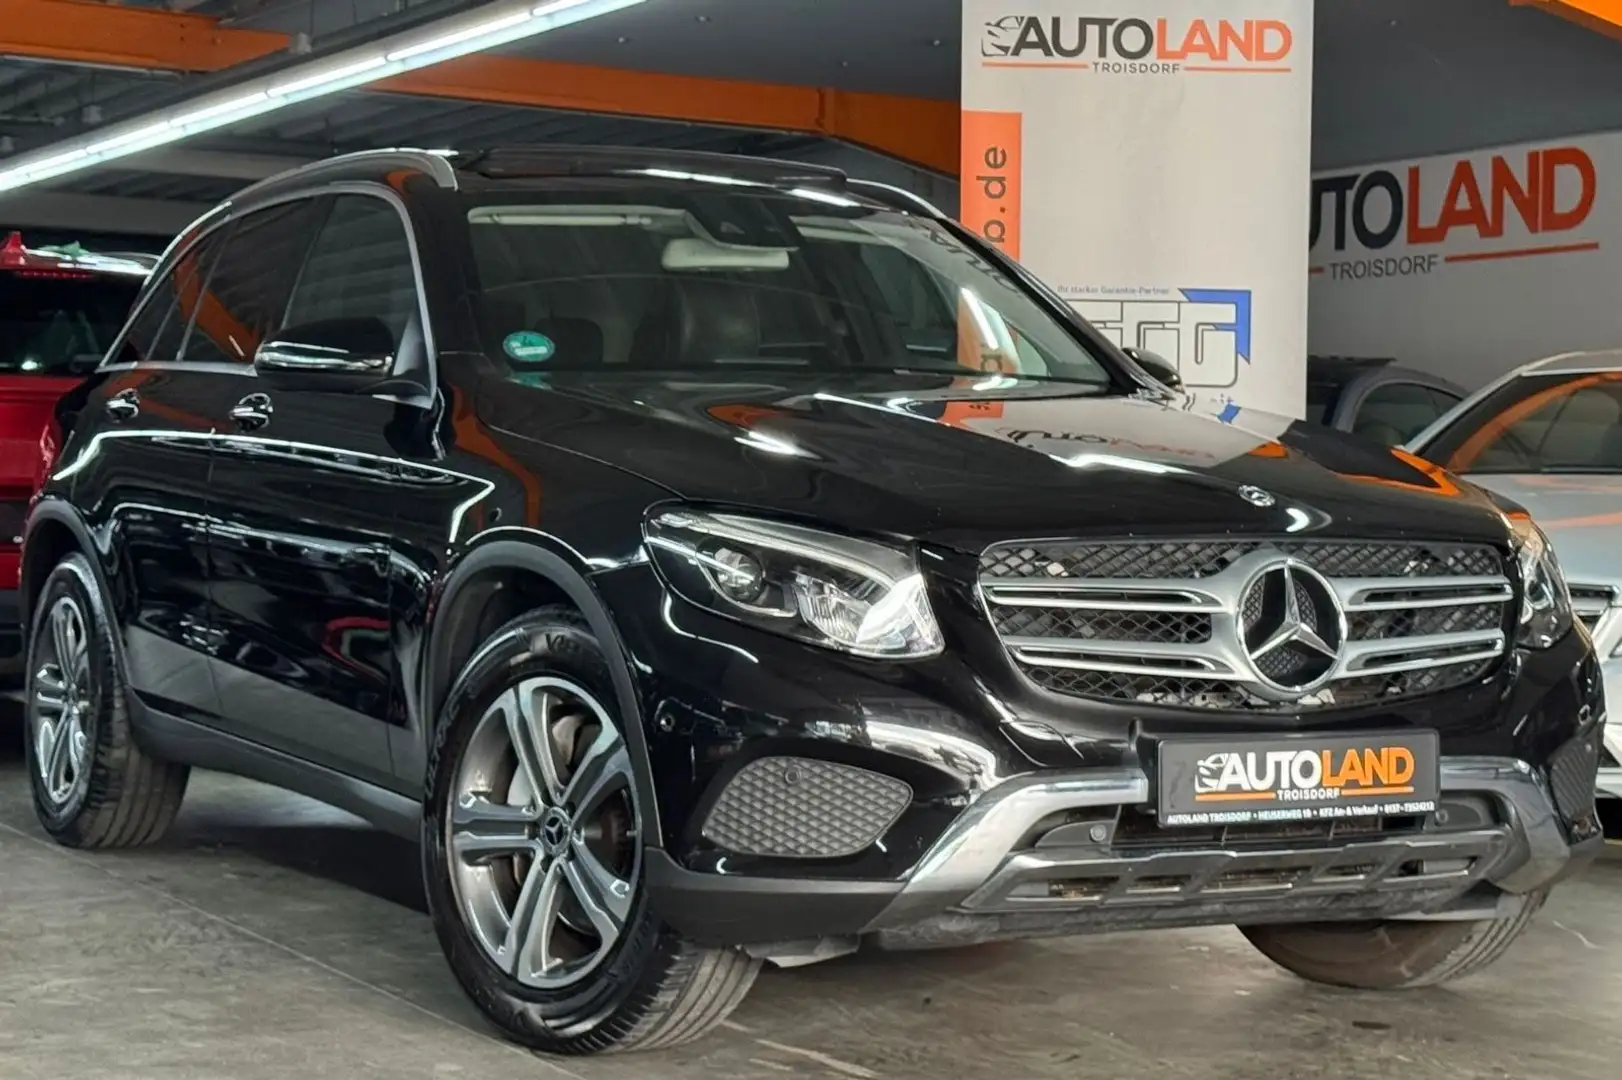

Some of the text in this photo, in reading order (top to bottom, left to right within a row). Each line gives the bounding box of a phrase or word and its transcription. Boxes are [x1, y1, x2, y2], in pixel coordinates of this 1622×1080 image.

[1010, 16, 1293, 62] AUTOLAND
[1092, 61, 1181, 75] TROISDORF
[1330, 253, 1439, 280] TROISDORF
[1217, 746, 1415, 791] AUTOLAND
[1277, 787, 1341, 801] TROISDORF
[1167, 813, 1209, 825] AUTOLAND
[1209, 811, 1251, 823] TROISDORF
